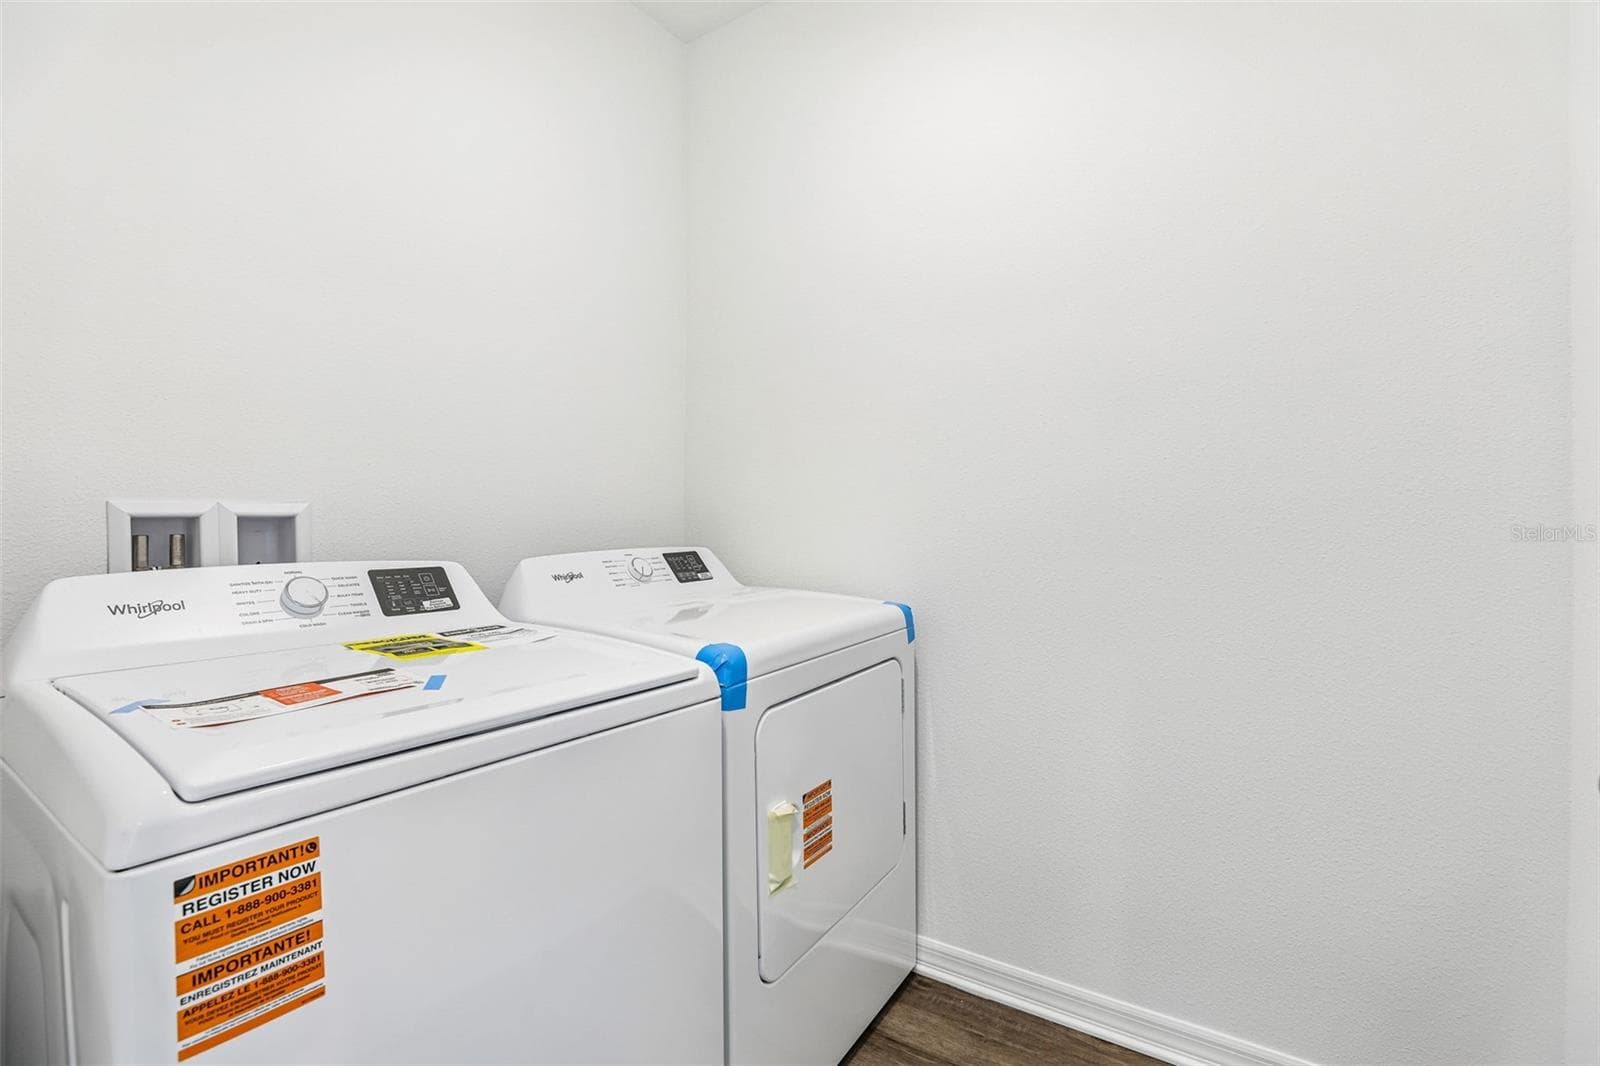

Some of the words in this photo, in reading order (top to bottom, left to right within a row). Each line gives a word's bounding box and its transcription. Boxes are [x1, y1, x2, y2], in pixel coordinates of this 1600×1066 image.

[551, 571, 585, 584] Whirlpool
[107, 600, 186, 619] Whirlpool
[182, 876, 273, 916] REGISTER
[278, 861, 316, 884] NOW
[199, 845, 304, 889] IMPORTANT!
[181, 913, 220, 934] CALL
[226, 879, 317, 918] 1-888-900-3381
[202, 926, 224, 938] MUST
[227, 912, 263, 929] REGISTER
[266, 903, 284, 915] YOUR
[286, 891, 318, 906] PRODUCT
[180, 968, 258, 1006] ENREGISTREZ
[260, 940, 323, 973] MAINTENANT
[192, 929, 310, 988] IMPORTANTE!
[183, 990, 235, 1019] APPELEZ
[237, 984, 251, 996] LE
